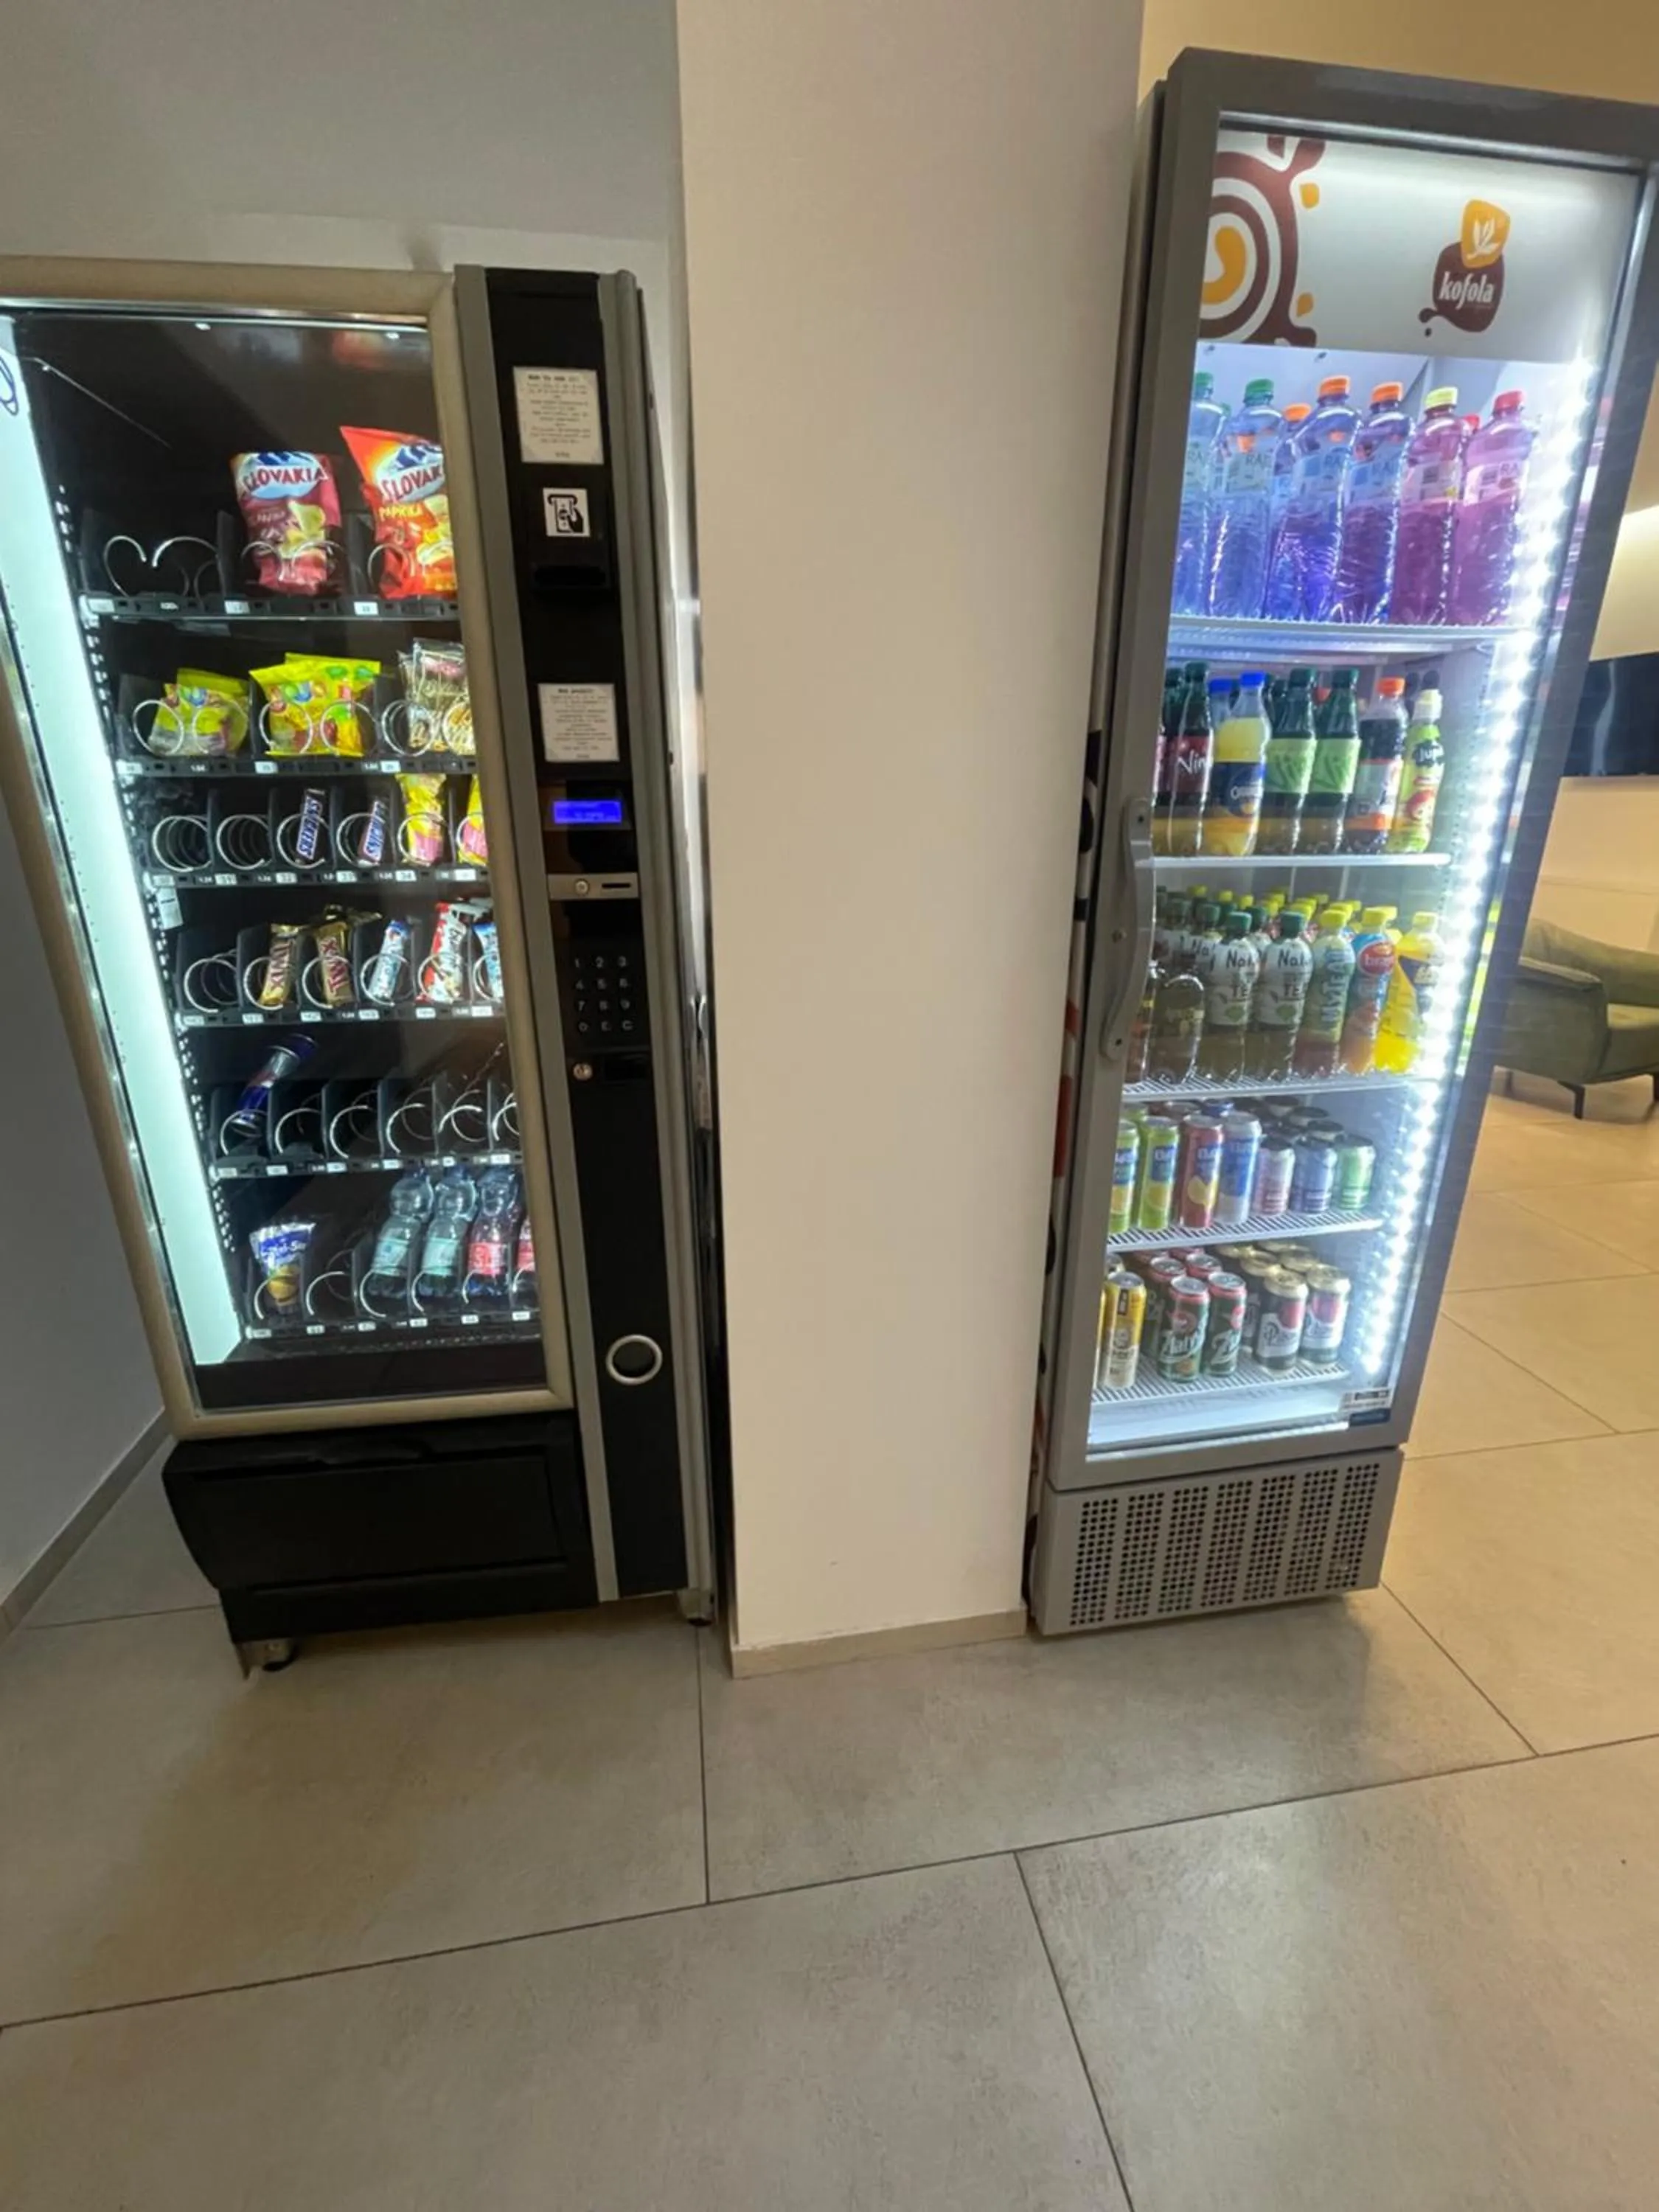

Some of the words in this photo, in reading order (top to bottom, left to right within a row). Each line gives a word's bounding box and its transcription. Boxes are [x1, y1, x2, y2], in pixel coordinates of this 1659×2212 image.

[1439, 271, 1494, 310] kofola
[243, 467, 327, 490] SLOVAKIA
[269, 940, 293, 992] TWIX
[322, 938, 349, 992] TWIX
